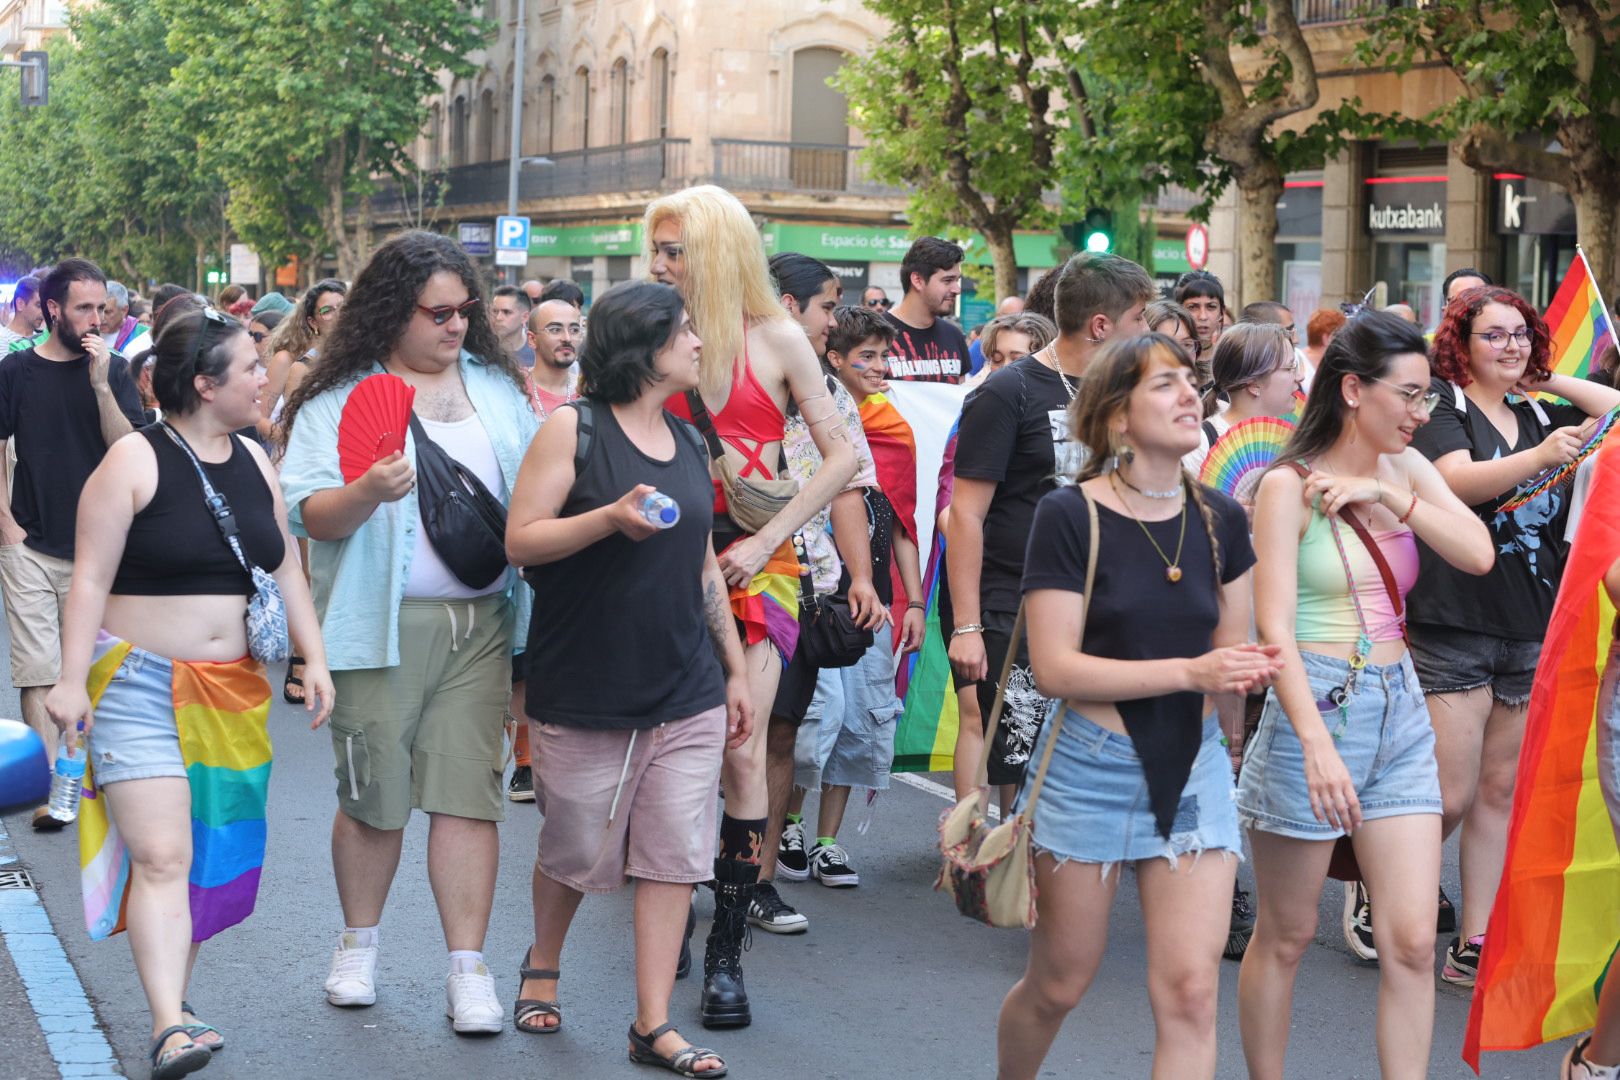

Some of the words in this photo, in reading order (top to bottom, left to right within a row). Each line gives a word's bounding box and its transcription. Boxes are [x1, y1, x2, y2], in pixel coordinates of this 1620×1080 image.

[1369, 202, 1443, 230] kutxabank
[1505, 184, 1521, 228] k
[502, 220, 524, 247] P
[820, 232, 868, 250] Espacio
[870, 234, 885, 249] de
[889, 359, 940, 378] WALKING
